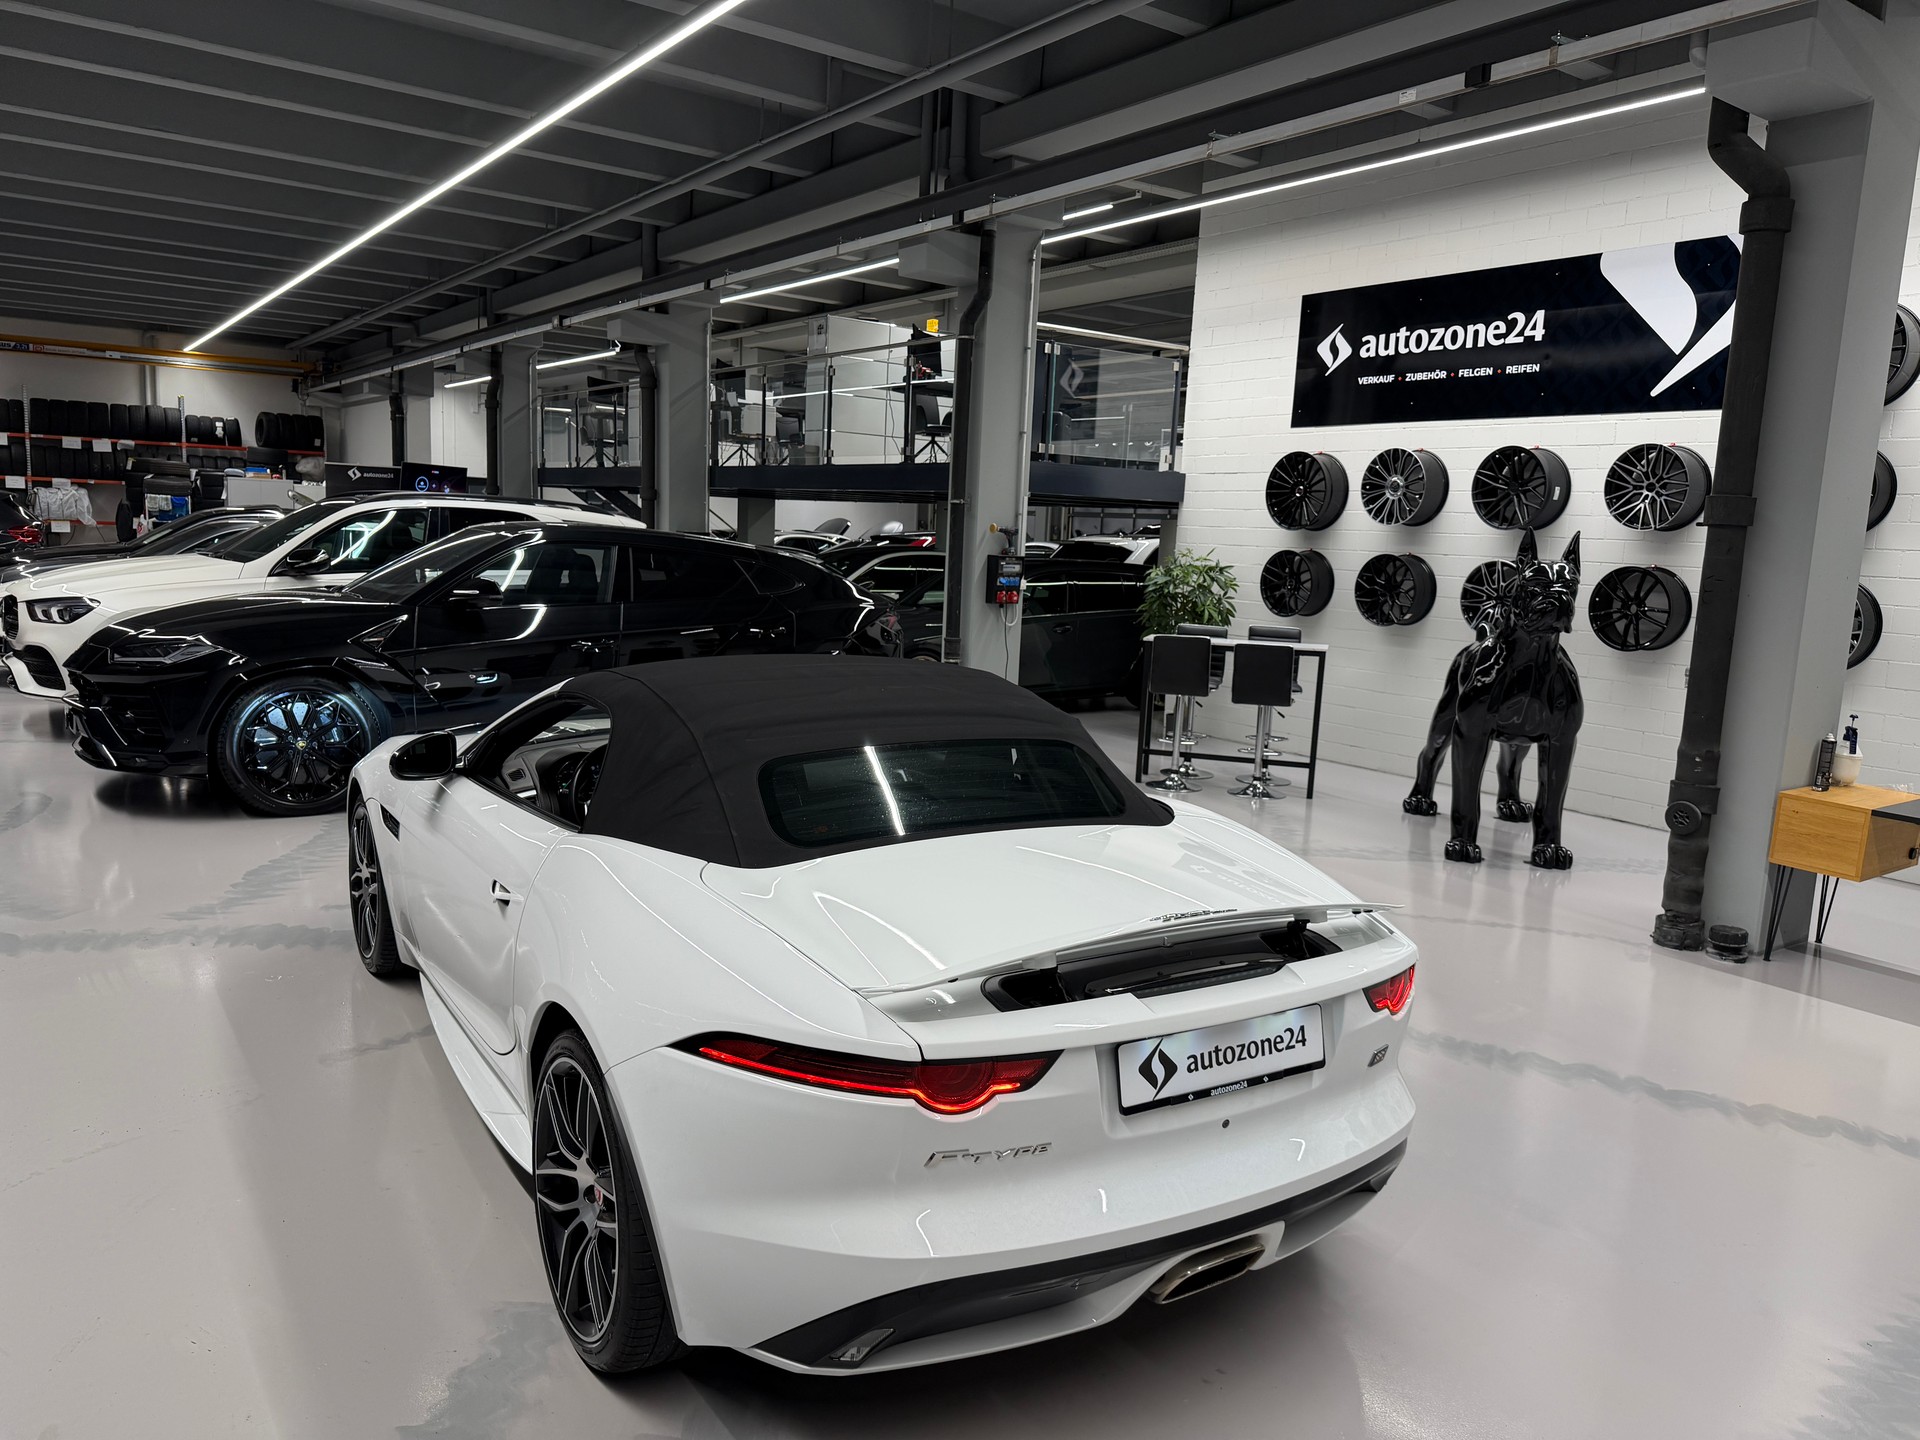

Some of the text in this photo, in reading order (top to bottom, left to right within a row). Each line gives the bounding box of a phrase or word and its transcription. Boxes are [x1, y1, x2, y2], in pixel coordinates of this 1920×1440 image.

[1359, 309, 1546, 358] autozone24
[1357, 363, 1541, 385] VERKAUF ZUBEHÖR FELGEN REIFEN
[1186, 1024, 1308, 1074] autozone24
[1210, 1080, 1248, 1097] autozone24
